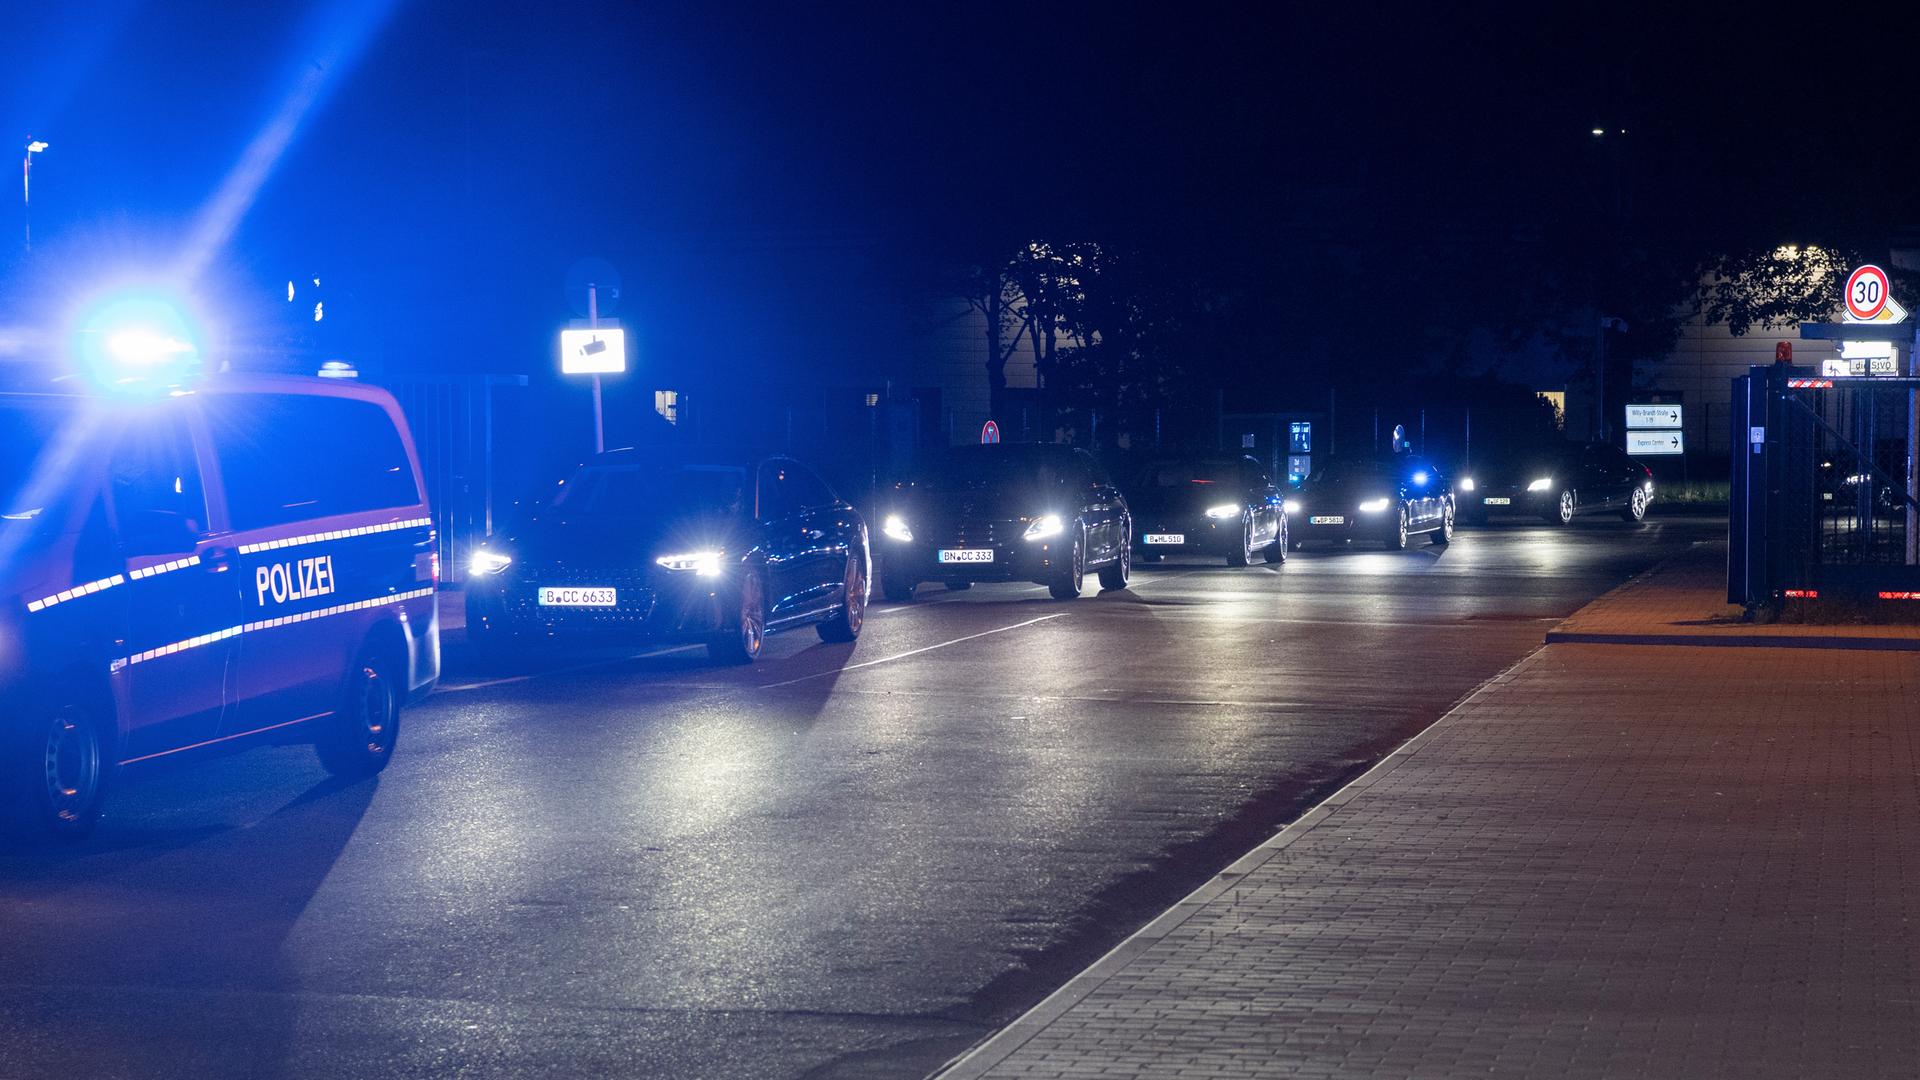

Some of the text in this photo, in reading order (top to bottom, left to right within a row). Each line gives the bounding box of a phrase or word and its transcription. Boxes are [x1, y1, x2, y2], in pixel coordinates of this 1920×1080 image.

[1855, 281, 1879, 303] 30
[944, 551, 992, 561] BN CC 333
[256, 555, 335, 607] POLIZEI
[547, 590, 613, 602] B CC 6633
